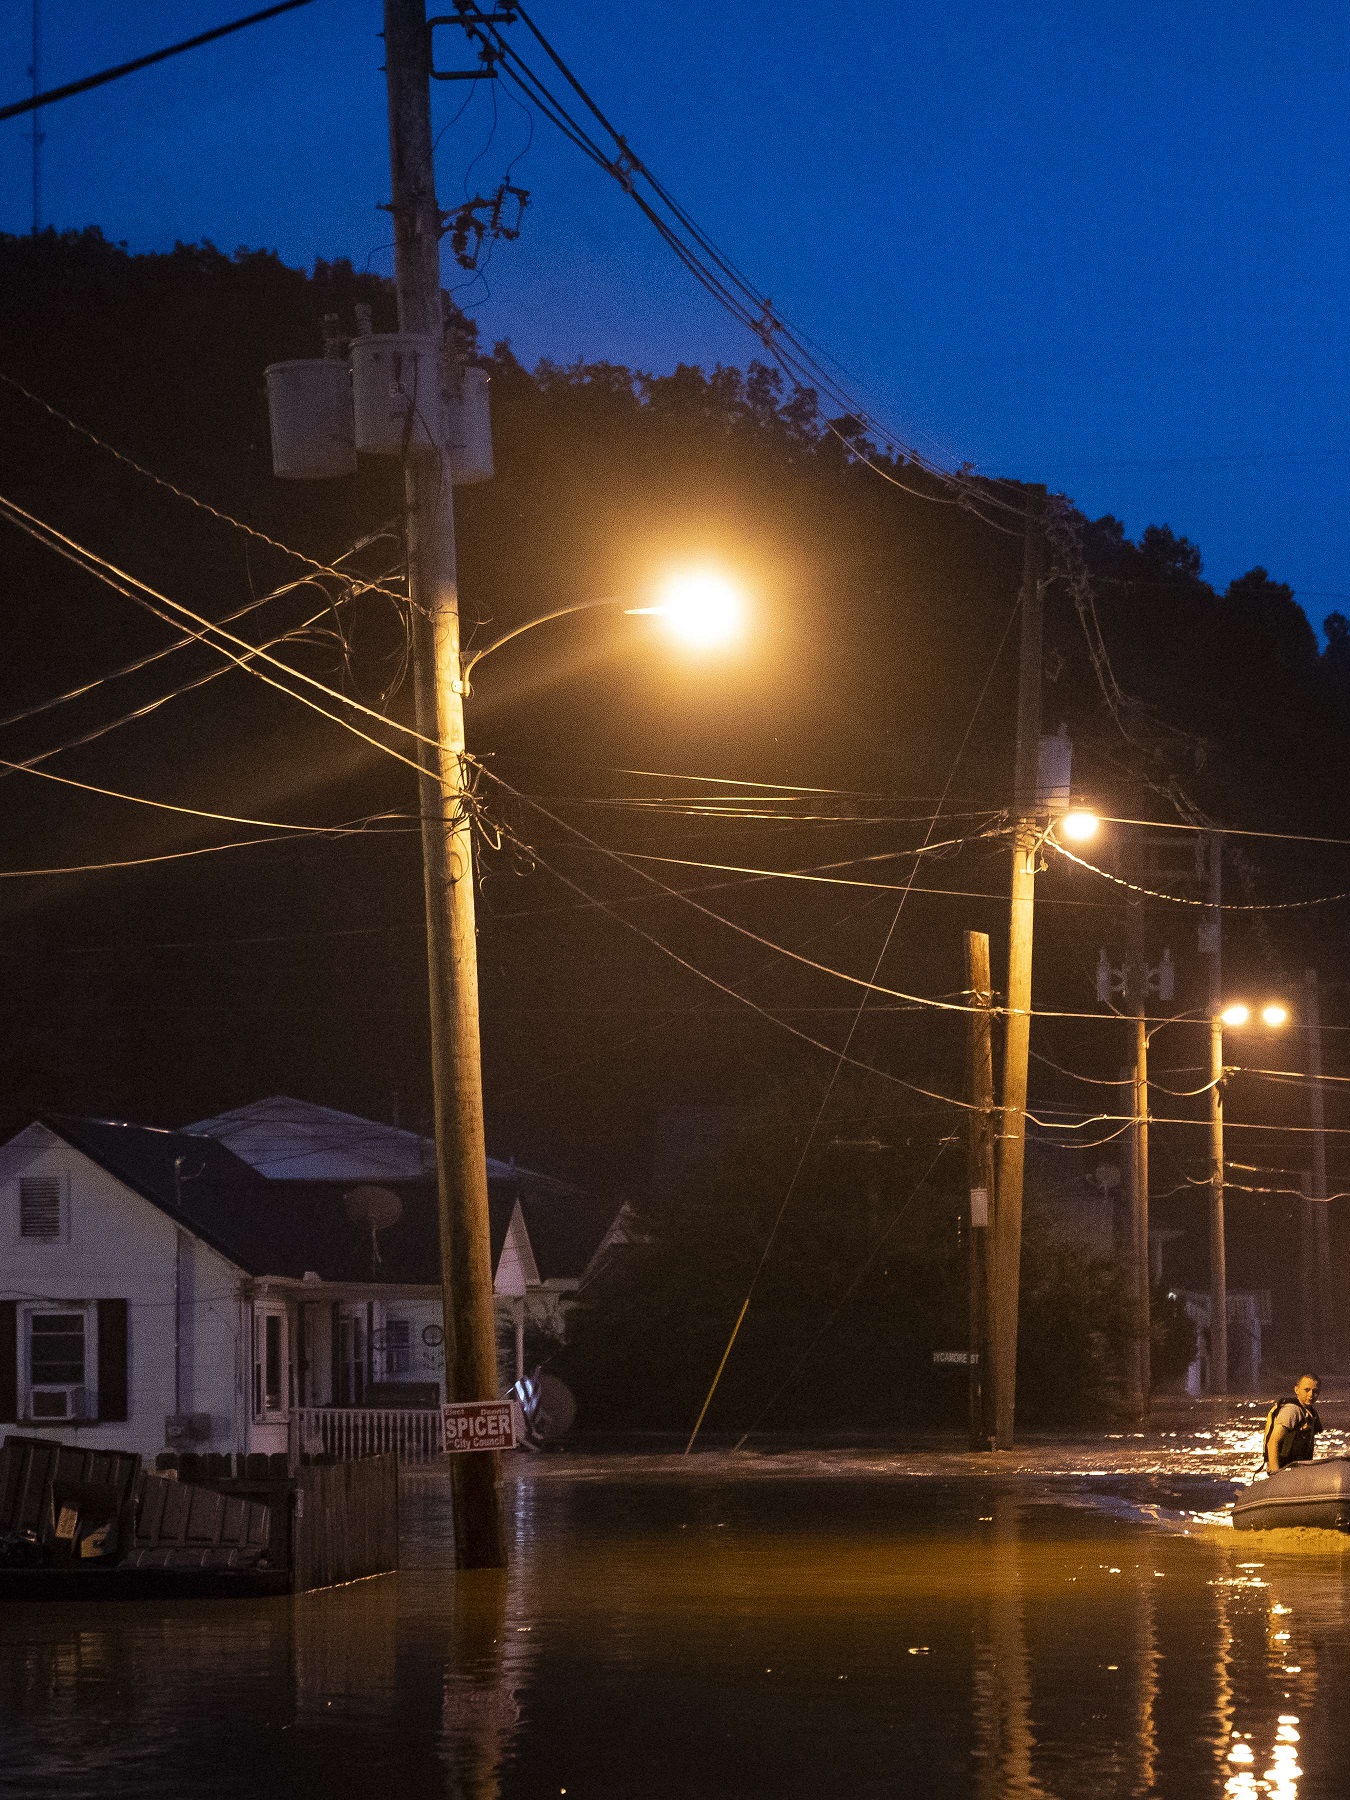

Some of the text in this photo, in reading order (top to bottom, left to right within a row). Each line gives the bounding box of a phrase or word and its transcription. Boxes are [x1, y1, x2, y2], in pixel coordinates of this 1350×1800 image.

[446, 1408, 510, 1416] Elect Dennis
[446, 1415, 511, 1438] SPICER
[454, 1438, 471, 1450] City
[473, 1435, 505, 1447] Council
